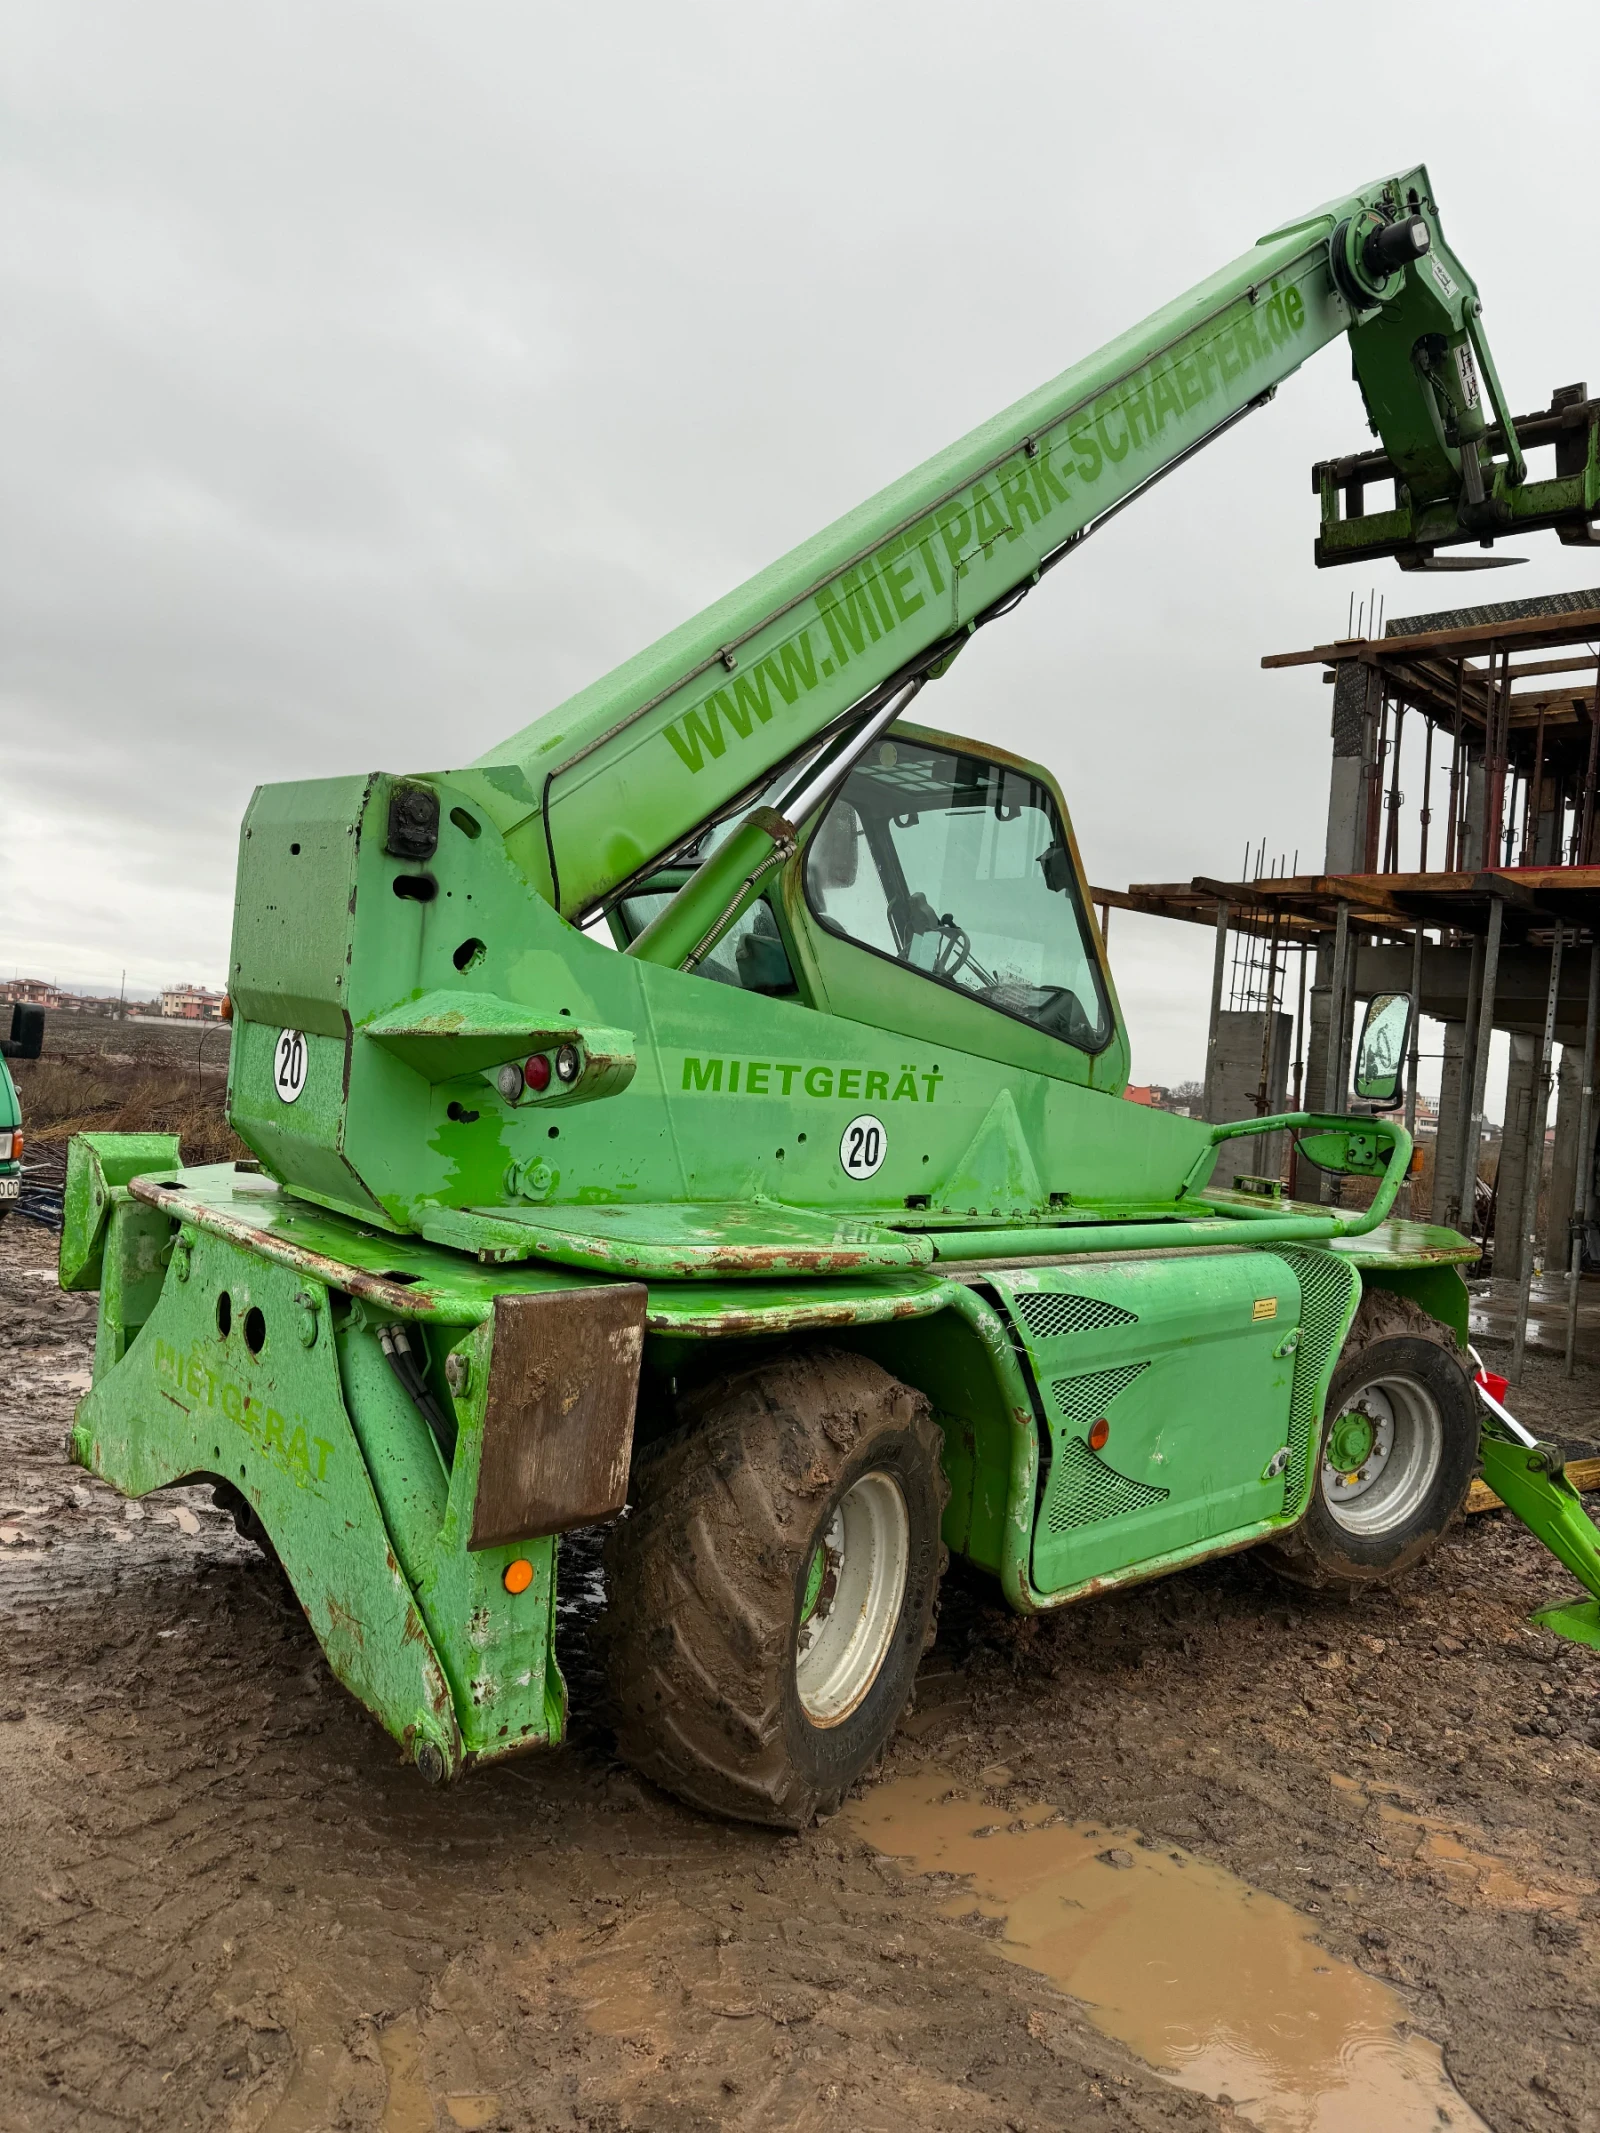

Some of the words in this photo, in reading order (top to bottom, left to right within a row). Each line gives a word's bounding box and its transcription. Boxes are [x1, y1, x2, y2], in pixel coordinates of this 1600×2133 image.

[279, 1038, 302, 1089] 20
[681, 1057, 944, 1103] MIETGERÄT
[849, 1127, 880, 1168] 20
